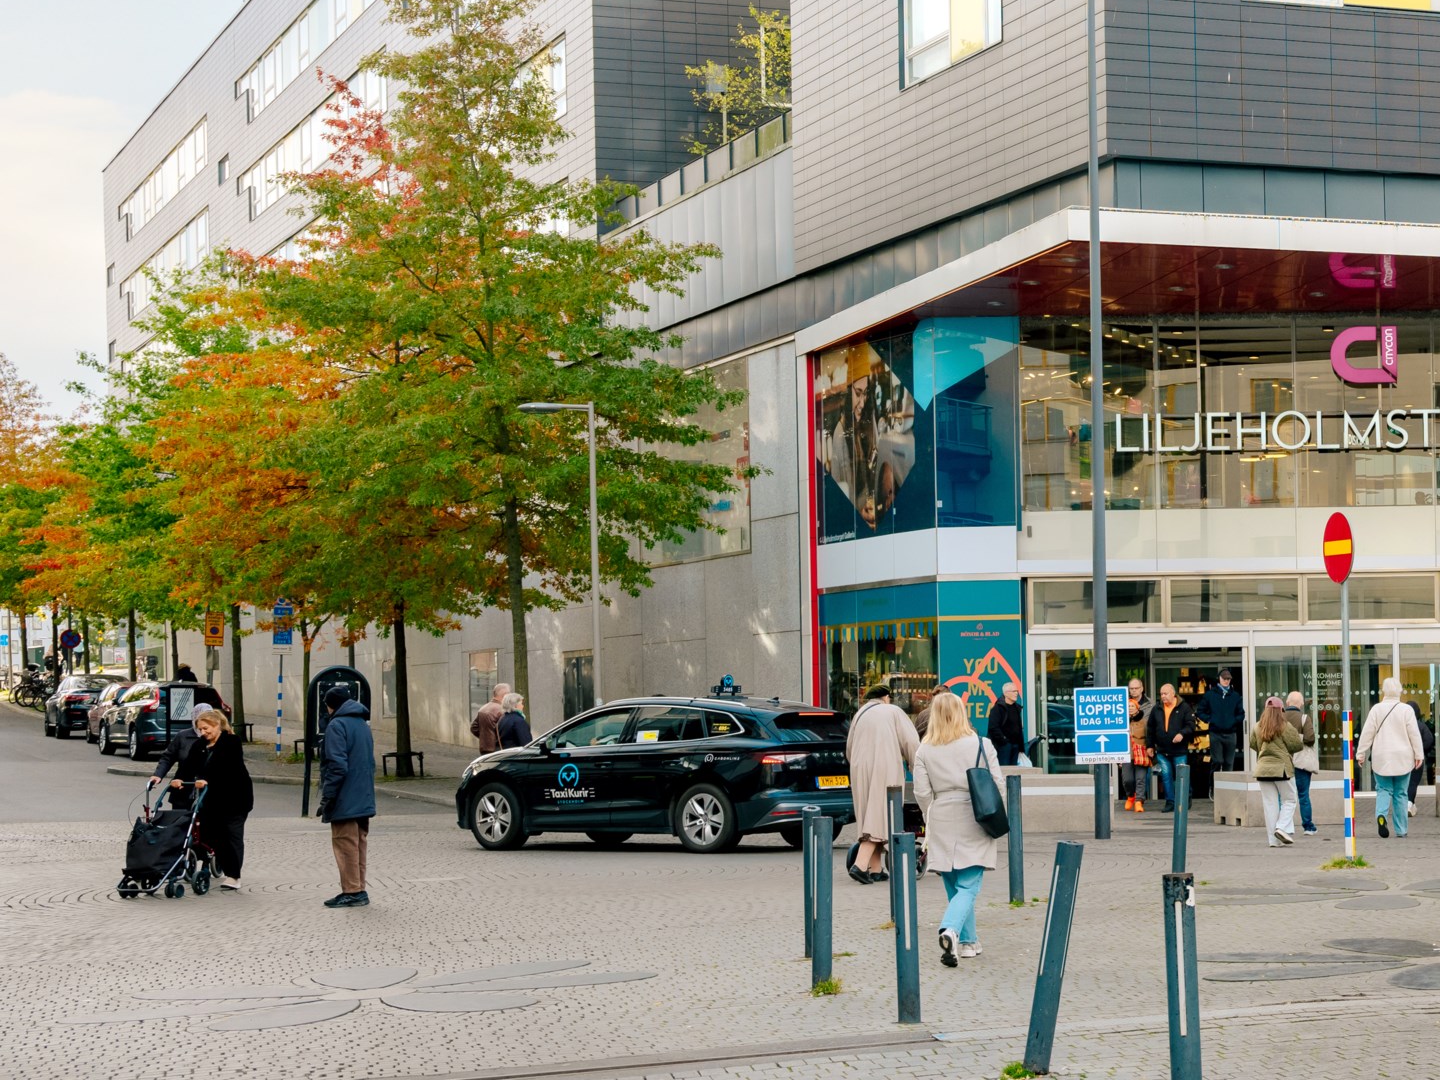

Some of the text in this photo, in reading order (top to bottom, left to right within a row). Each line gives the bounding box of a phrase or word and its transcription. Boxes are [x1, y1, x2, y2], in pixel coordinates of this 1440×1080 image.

[1384, 328, 1393, 366] CITYCON
[963, 658, 998, 674] YOU
[967, 680, 993, 696] ME
[1079, 694, 1123, 703] BAKLUCKE
[1078, 704, 1125, 716] LOPPIS
[1080, 717, 1102, 726] IDAG
